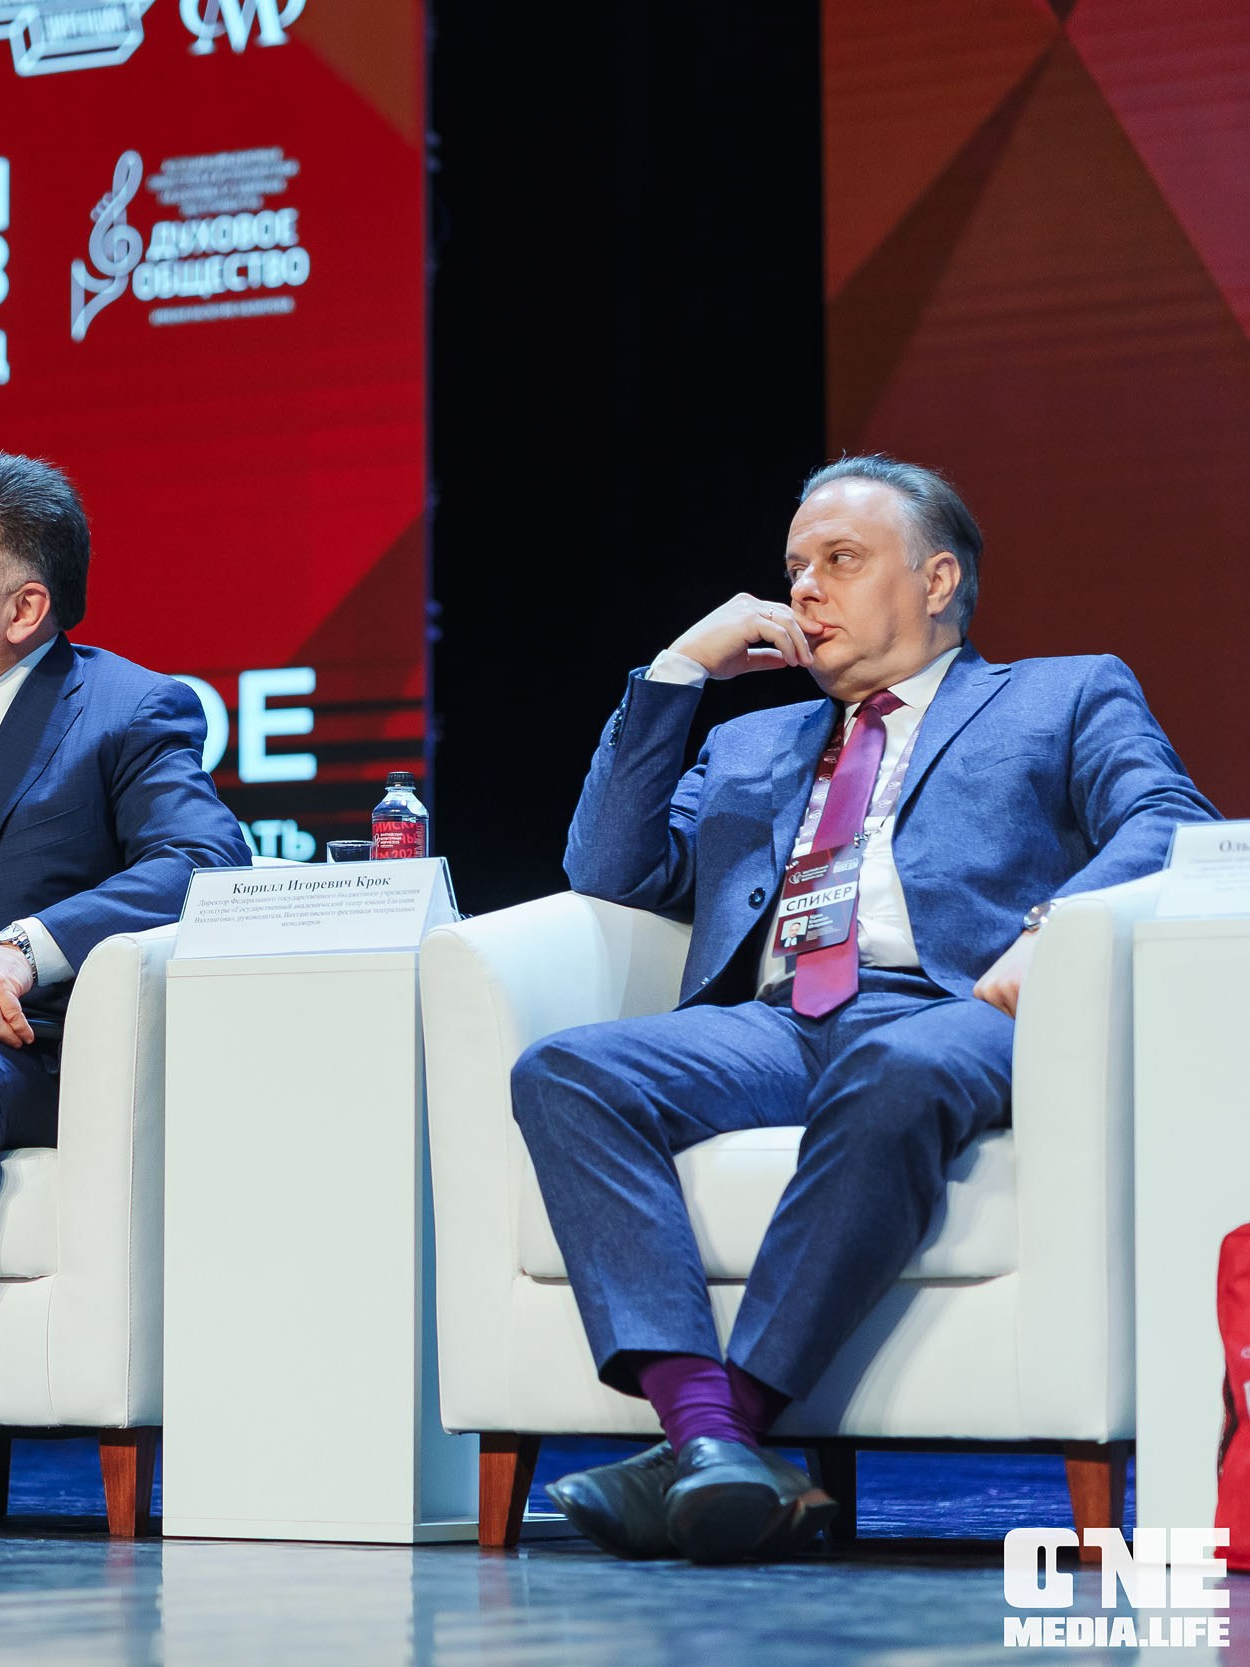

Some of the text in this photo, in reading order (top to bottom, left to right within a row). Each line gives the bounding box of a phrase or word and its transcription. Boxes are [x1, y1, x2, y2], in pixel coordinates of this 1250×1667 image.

[146, 208, 299, 262] ДУХОВОЕ
[132, 247, 311, 301] ОБЩЕСТВО
[232, 875, 391, 896] Кирилл Игоревич Крок
[786, 886, 852, 912] СПИКЕР
